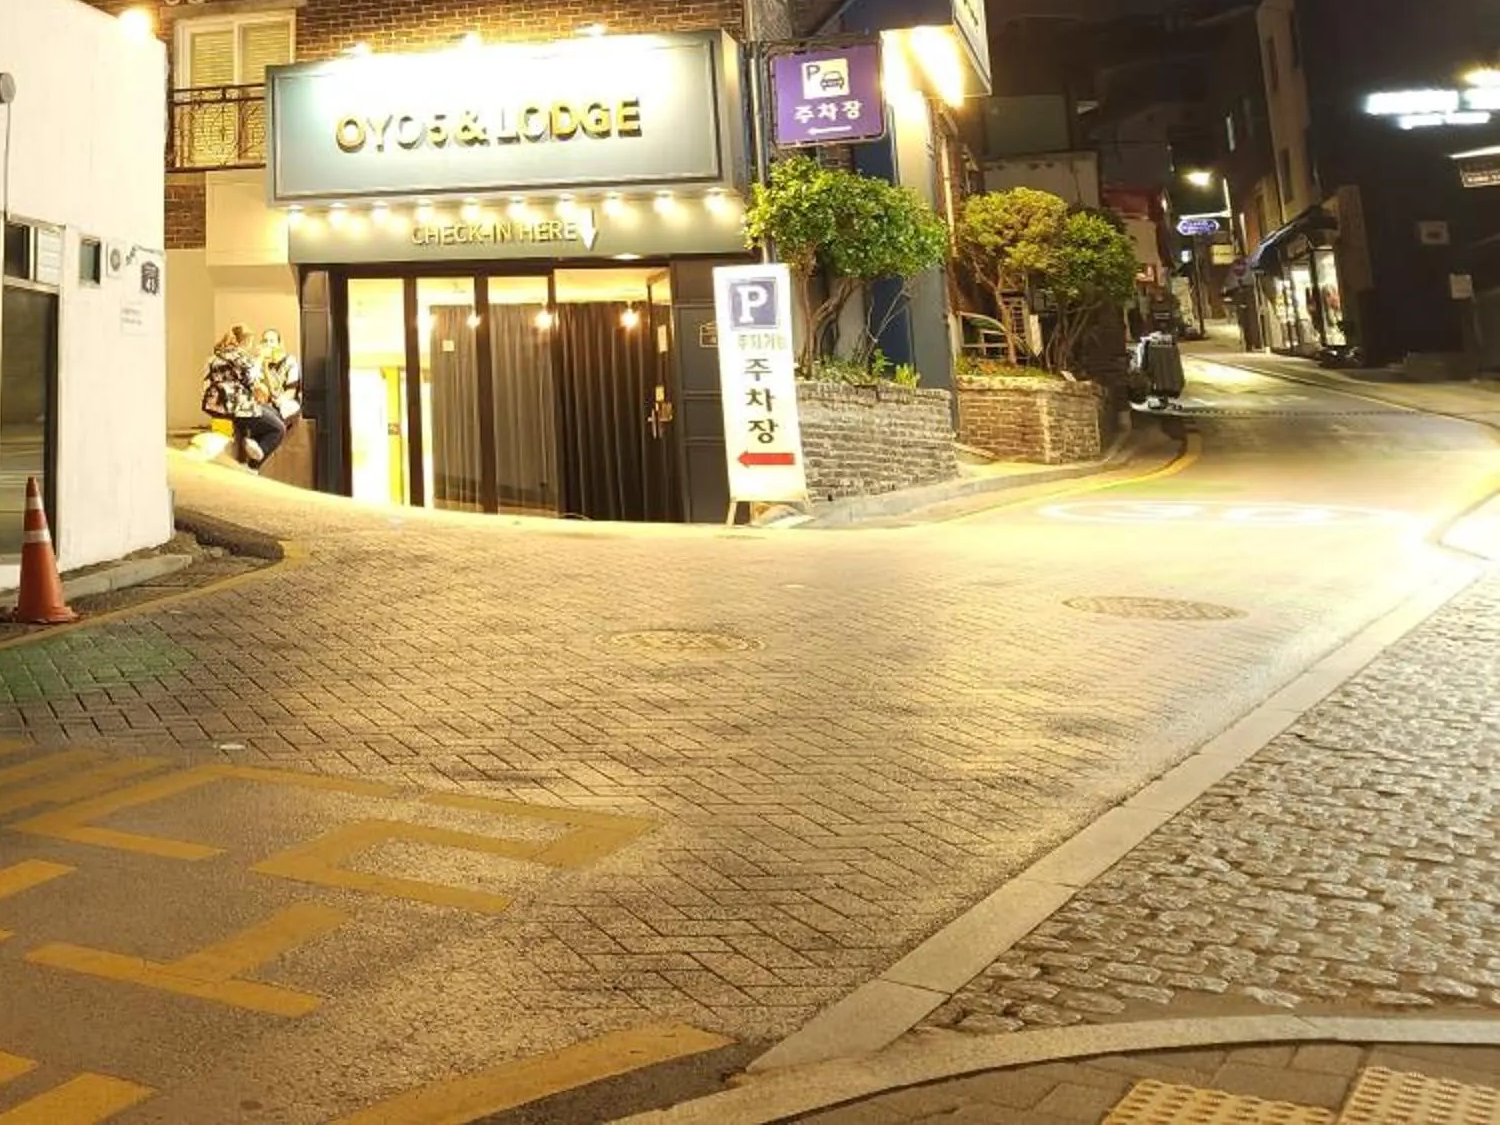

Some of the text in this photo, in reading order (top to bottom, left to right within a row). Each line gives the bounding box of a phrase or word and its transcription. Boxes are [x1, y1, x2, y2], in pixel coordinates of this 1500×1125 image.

[806, 64, 821, 81] P
[794, 100, 863, 124] 주차장
[411, 220, 579, 246] CHECK-IN HERE
[737, 284, 769, 324] P
[744, 358, 778, 445] 주차장
